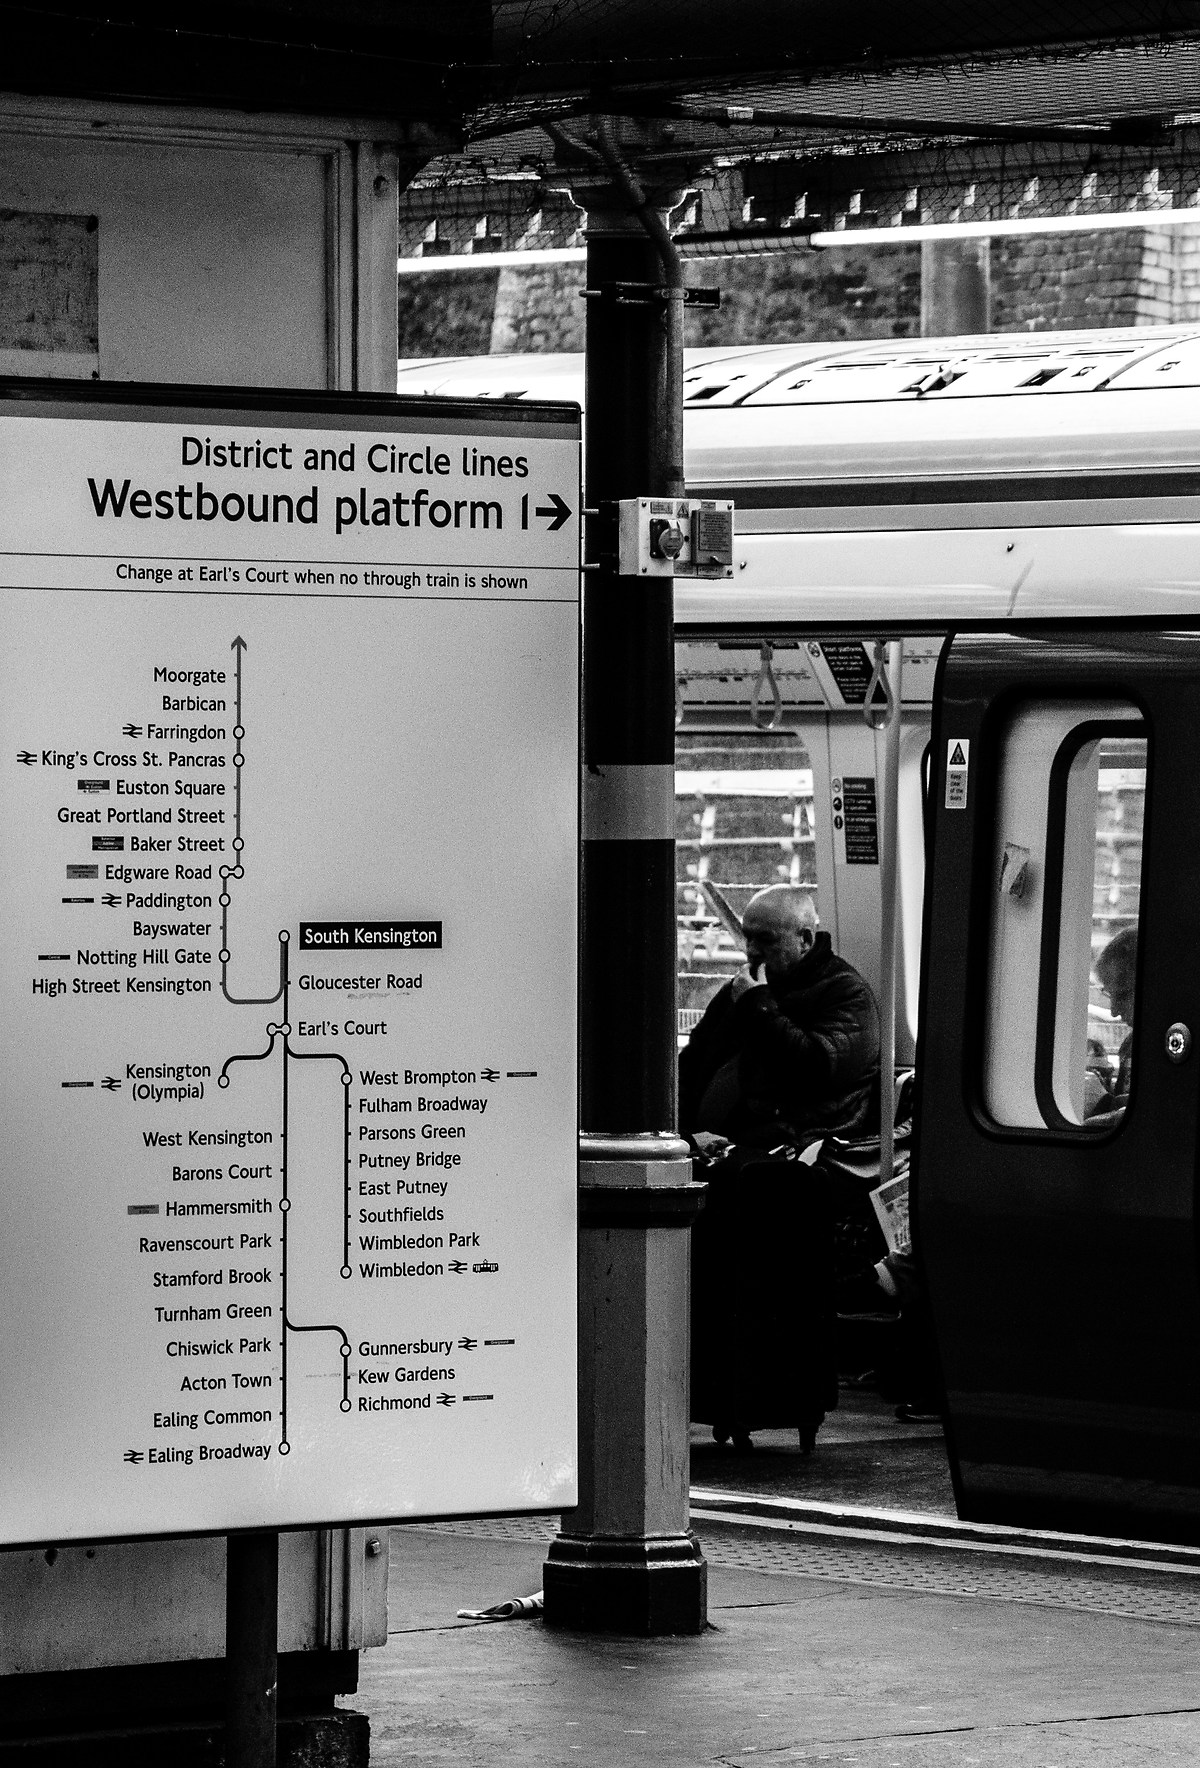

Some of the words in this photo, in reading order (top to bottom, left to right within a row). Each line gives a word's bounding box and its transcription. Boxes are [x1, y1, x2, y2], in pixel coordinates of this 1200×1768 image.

[182, 437, 292, 469] District
[304, 443, 355, 471] and
[368, 444, 450, 475] Circle
[463, 448, 529, 478] lines
[88, 478, 318, 524] Westbound
[336, 488, 502, 534] platform
[116, 564, 172, 584] Change
[178, 567, 193, 581] at
[200, 566, 240, 582] Earl's
[245, 567, 288, 583] Court
[294, 569, 334, 584] when
[340, 573, 358, 585] no
[363, 571, 421, 590] through
[426, 573, 459, 587] train
[465, 573, 476, 588] is
[481, 574, 528, 589] shown
[154, 667, 226, 686] Moorgate
[163, 695, 226, 711] Barbican
[148, 724, 226, 743] Farringdon
[42, 751, 88, 770] King's
[93, 751, 137, 766] Cross
[143, 751, 162, 767] St.
[169, 752, 226, 767] Pancras
[117, 779, 169, 795] Euston
[175, 780, 225, 798] Square
[57, 807, 101, 823] Great
[108, 808, 172, 823] Portland
[178, 808, 225, 823] Street
[131, 836, 172, 851] Baker
[178, 836, 225, 851] Street
[106, 865, 169, 883] Edgware
[176, 864, 212, 879] Road
[127, 893, 212, 911] Paddington
[134, 921, 211, 939] Bayswater
[305, 929, 349, 944] South
[355, 928, 437, 946] Kensington
[77, 950, 137, 968] Notting
[143, 949, 169, 964] Hill
[175, 949, 211, 964] Gate
[32, 978, 67, 997] High
[72, 978, 120, 993] Street
[127, 977, 211, 995] Kensington
[299, 975, 381, 990] Gloucester
[387, 974, 422, 989] Road
[299, 1021, 338, 1036] Earl's
[344, 1020, 387, 1035] Court
[126, 1063, 211, 1081] Kensington
[360, 1071, 398, 1085] West
[404, 1070, 476, 1087] Brompton
[132, 1082, 204, 1103] (Olympia)
[359, 1098, 412, 1113] Fulham
[418, 1096, 487, 1114] Broadway
[143, 1132, 182, 1147] West
[189, 1130, 272, 1148] Kensington
[359, 1126, 416, 1140] Parsons
[421, 1124, 465, 1139] Green
[359, 1153, 410, 1170] Putney
[416, 1151, 461, 1169] Bridge
[173, 1166, 223, 1181] Barons
[228, 1164, 272, 1179] Court
[359, 1181, 390, 1196] East
[397, 1180, 448, 1196] Putney
[166, 1198, 272, 1216] Hammersmith
[359, 1206, 444, 1223] Southfields
[140, 1236, 234, 1253] Ravenscourt
[240, 1233, 271, 1248] Park
[359, 1234, 443, 1250] Wimbledon
[449, 1232, 479, 1247] Park
[153, 1270, 223, 1287] Stamford
[229, 1268, 271, 1284] Brook
[359, 1261, 443, 1278] Wimbledon
[154, 1306, 221, 1322] Turnham
[226, 1304, 272, 1319] Green
[166, 1339, 233, 1357] Chiswick
[240, 1338, 271, 1353] Park
[359, 1339, 453, 1356] Gunnersbury
[180, 1376, 226, 1391] Acton
[232, 1373, 272, 1388] Town
[359, 1369, 389, 1384] Kew
[395, 1366, 455, 1382] Gardens
[358, 1394, 431, 1411] Richmond
[154, 1412, 198, 1430] Ealing
[204, 1410, 272, 1425] Common
[149, 1447, 193, 1465] Ealing
[199, 1443, 271, 1460] Broadway
